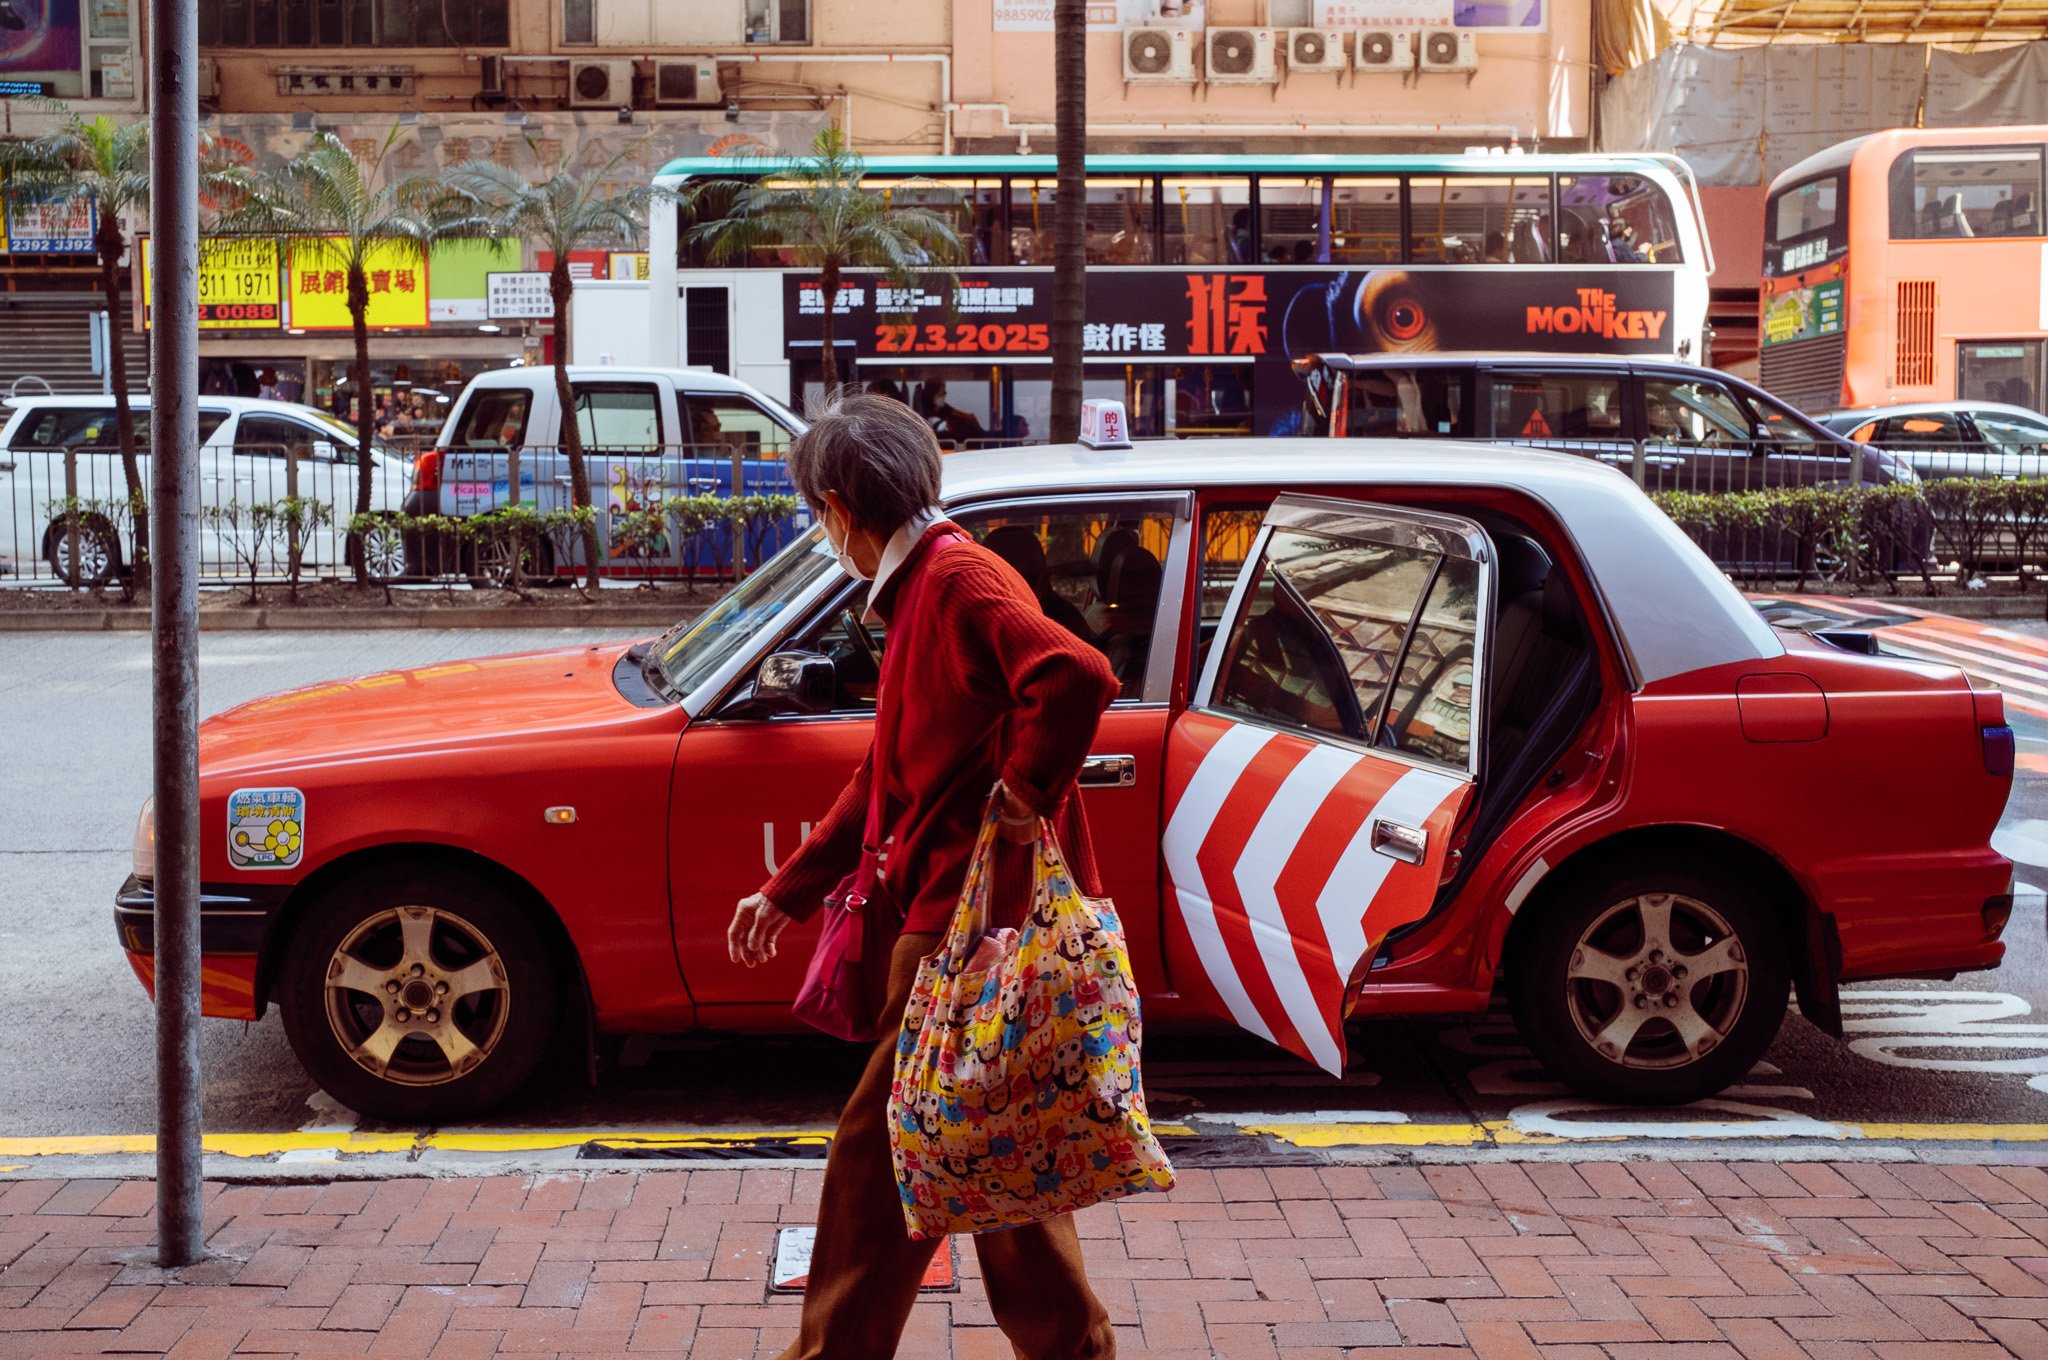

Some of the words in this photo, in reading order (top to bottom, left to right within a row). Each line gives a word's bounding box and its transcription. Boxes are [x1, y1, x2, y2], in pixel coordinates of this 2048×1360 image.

[995, 9, 1054, 21] 9885902
[12, 240, 49, 251] 2392
[54, 240, 92, 251] 3392
[199, 273, 225, 297] 311
[235, 273, 271, 297] 1971
[300, 269, 416, 295] 展銷賣場
[215, 305, 274, 319] 0088
[1577, 288, 1617, 312] THE
[1184, 274, 1268, 354] 猴
[1526, 306, 1668, 339] MONKEY
[875, 324, 1050, 352] 27.3.2025
[1082, 323, 1166, 351] 鼓作怪
[1104, 411, 1119, 438] 的士
